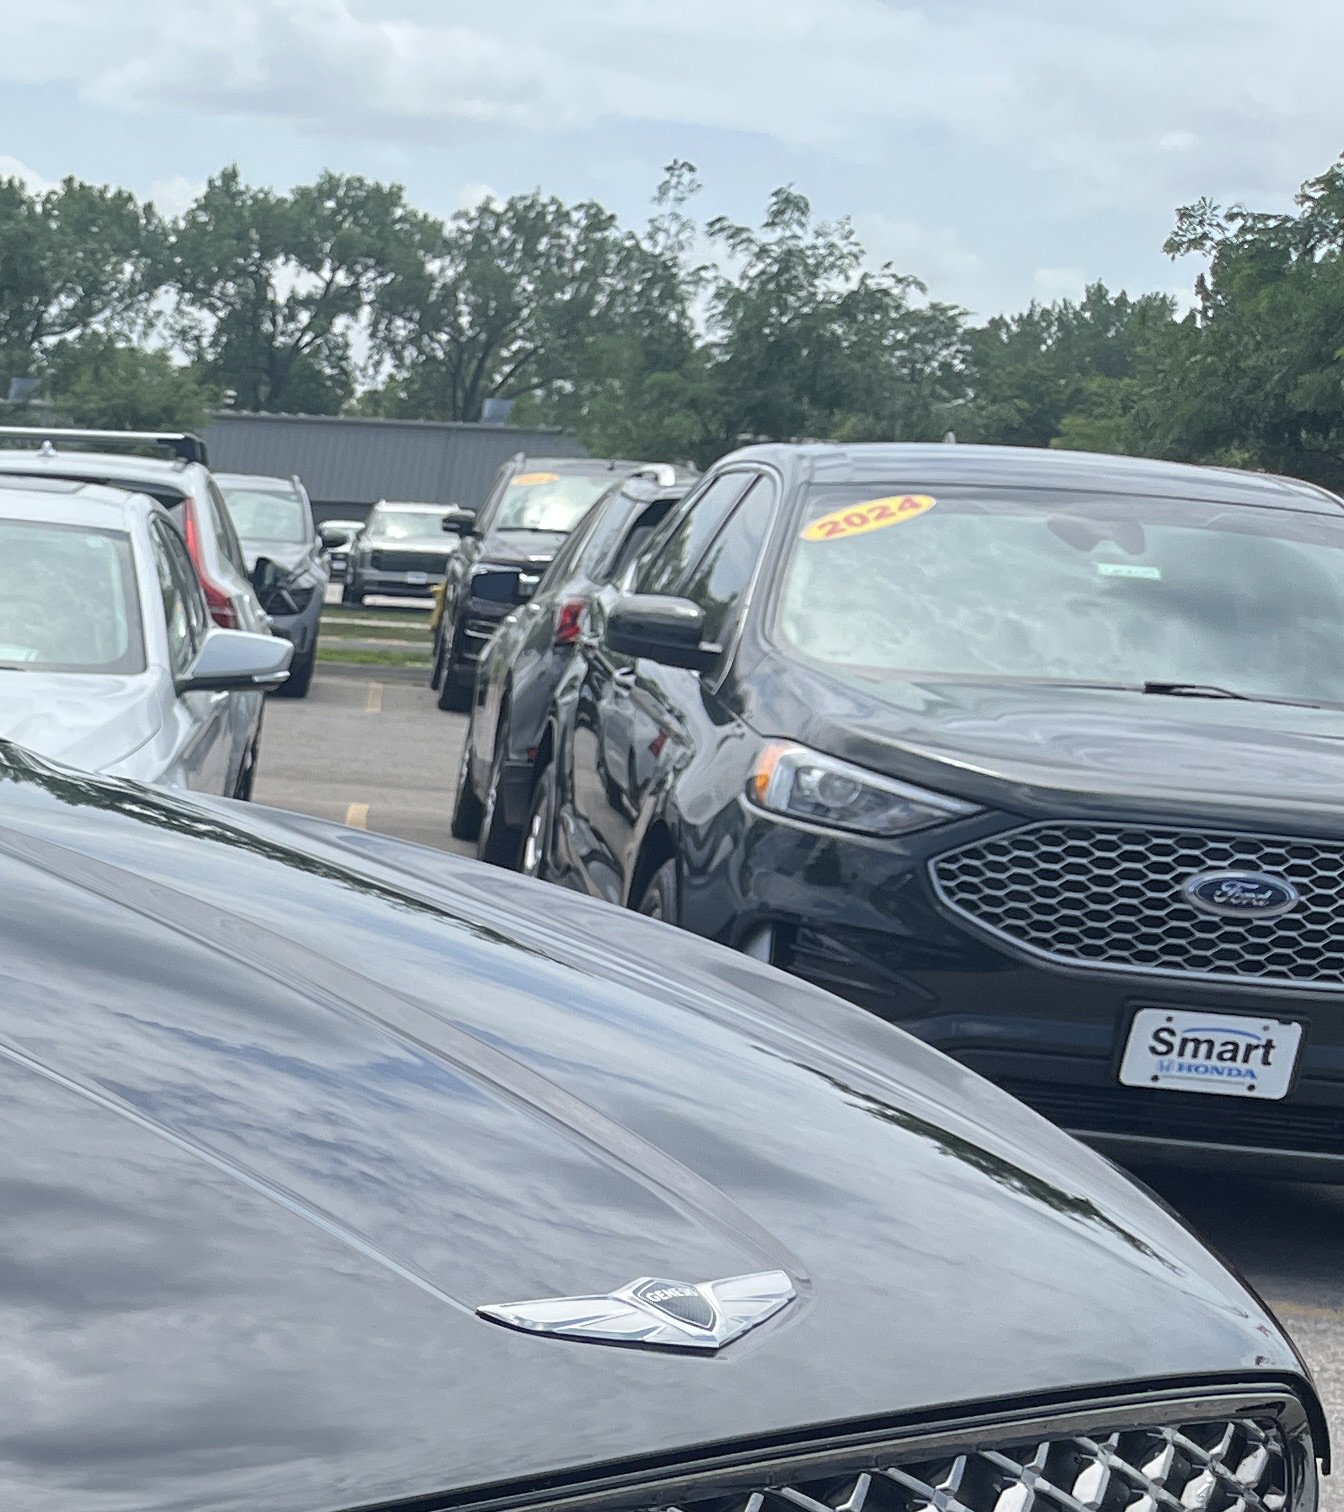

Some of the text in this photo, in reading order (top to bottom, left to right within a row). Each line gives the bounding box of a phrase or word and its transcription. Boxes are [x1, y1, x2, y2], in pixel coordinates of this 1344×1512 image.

[818, 496, 922, 537] 2024
[1213, 880, 1273, 907] Ford
[1149, 1026, 1275, 1067] Smart
[1176, 1062, 1257, 1080] HONDA
